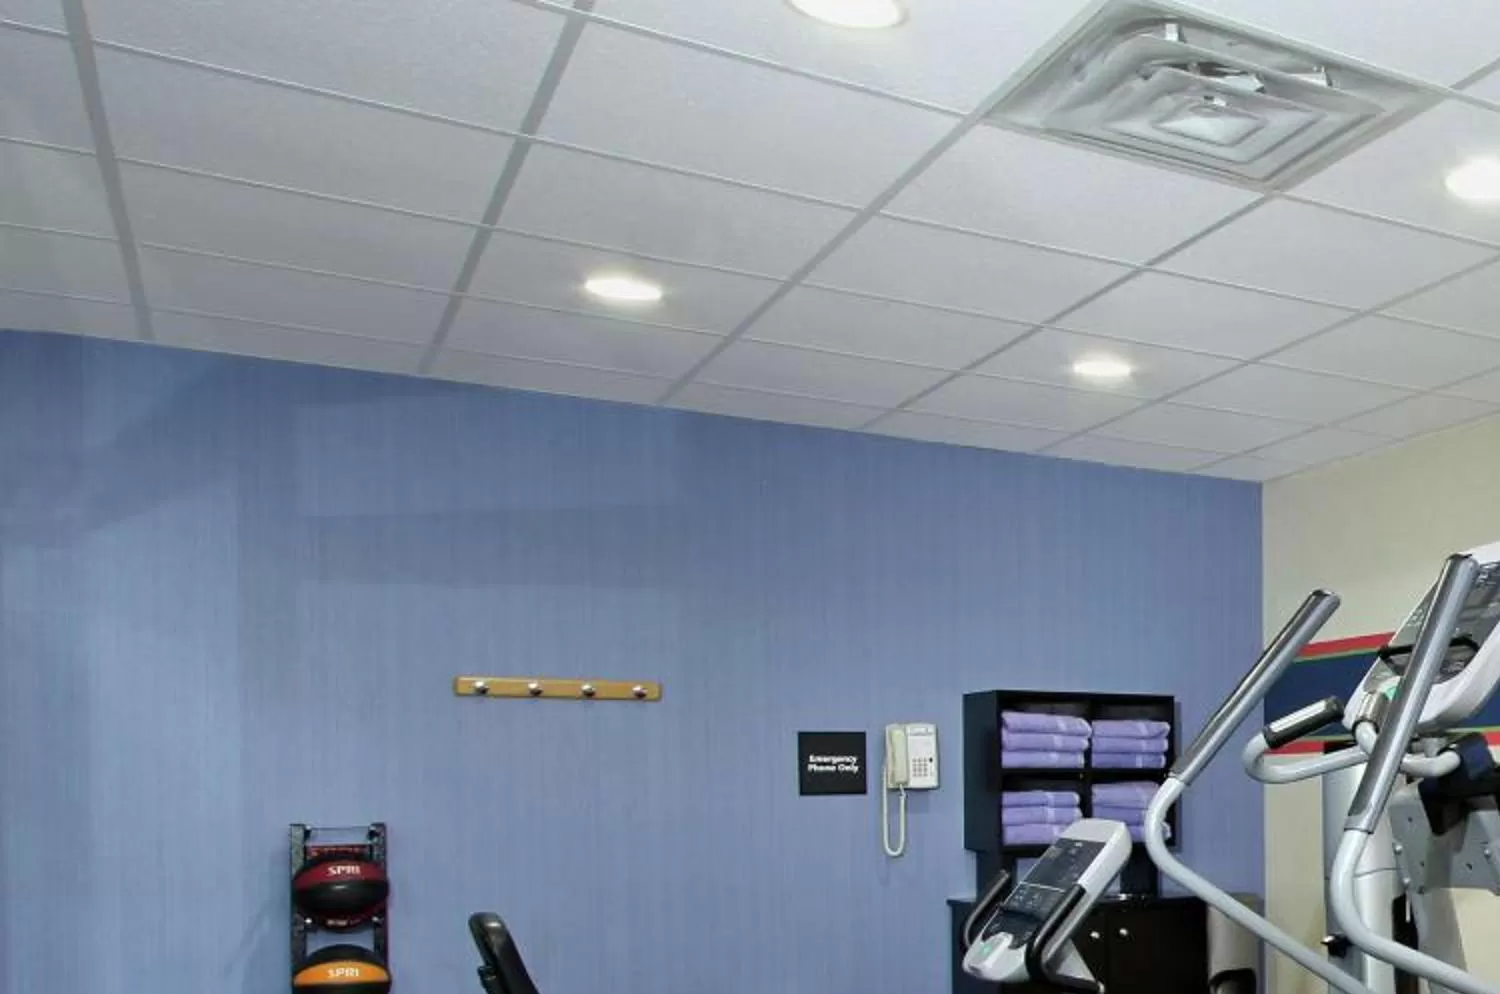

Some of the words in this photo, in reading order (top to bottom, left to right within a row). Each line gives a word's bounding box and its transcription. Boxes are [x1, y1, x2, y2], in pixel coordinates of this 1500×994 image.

[808, 755, 857, 765] Emergency
[808, 763, 836, 772] Phone
[837, 763, 858, 774] Only
[328, 865, 361, 876] SPRI
[327, 967, 360, 978] SPRI
